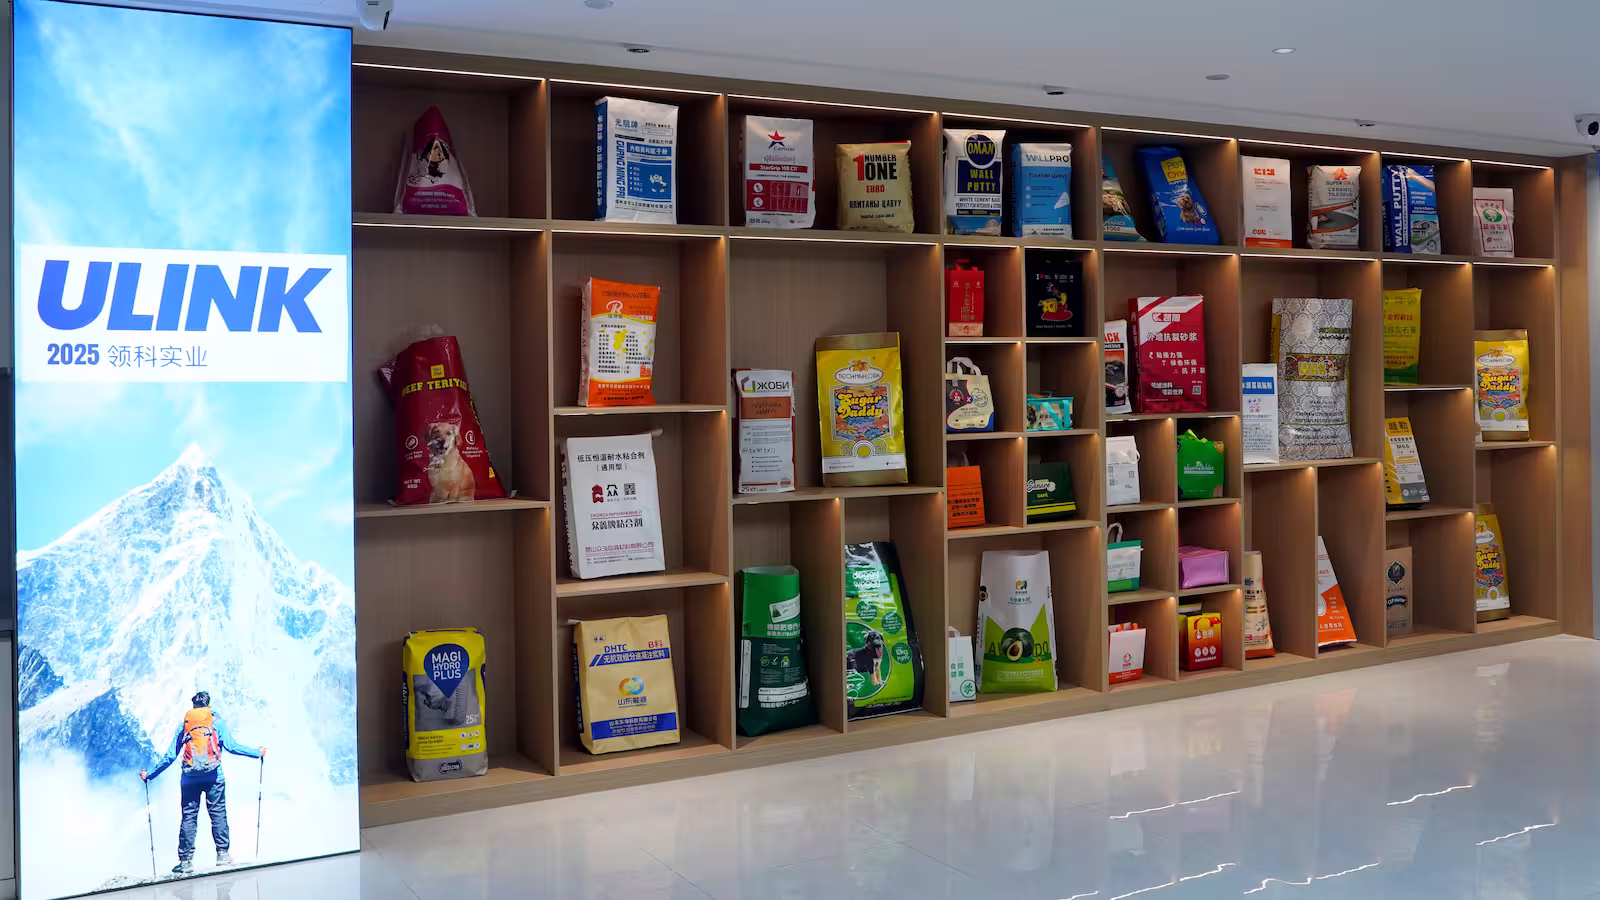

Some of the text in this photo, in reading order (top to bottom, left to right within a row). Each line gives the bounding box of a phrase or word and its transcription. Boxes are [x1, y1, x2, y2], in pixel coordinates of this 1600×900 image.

[967, 142, 994, 155] OMAN
[864, 154, 897, 162] NUMBER
[865, 162, 898, 180] ONE
[969, 169, 994, 179] WALL
[866, 184, 885, 193] EURO
[967, 181, 996, 192] PUTTY
[1391, 169, 1403, 247] WALL PUTTY
[38, 260, 333, 333] ULINK
[1147, 332, 1198, 342] 外墙抗裂砂浆
[47, 343, 208, 367] 2025 领科实业
[1480, 372, 1516, 383] Sugar
[402, 381, 424, 397] BEEF
[757, 381, 790, 390] ЖОБИ
[1480, 382, 1516, 393] Daddy
[838, 393, 883, 406] Sugar
[838, 405, 884, 419] Daddy
[577, 451, 646, 463] 低压恒温耐水粘合剂
[604, 643, 628, 653] DHTC
[431, 650, 462, 664] MAGI
[432, 662, 461, 672] HYDRO
[433, 669, 462, 681] PLUS
